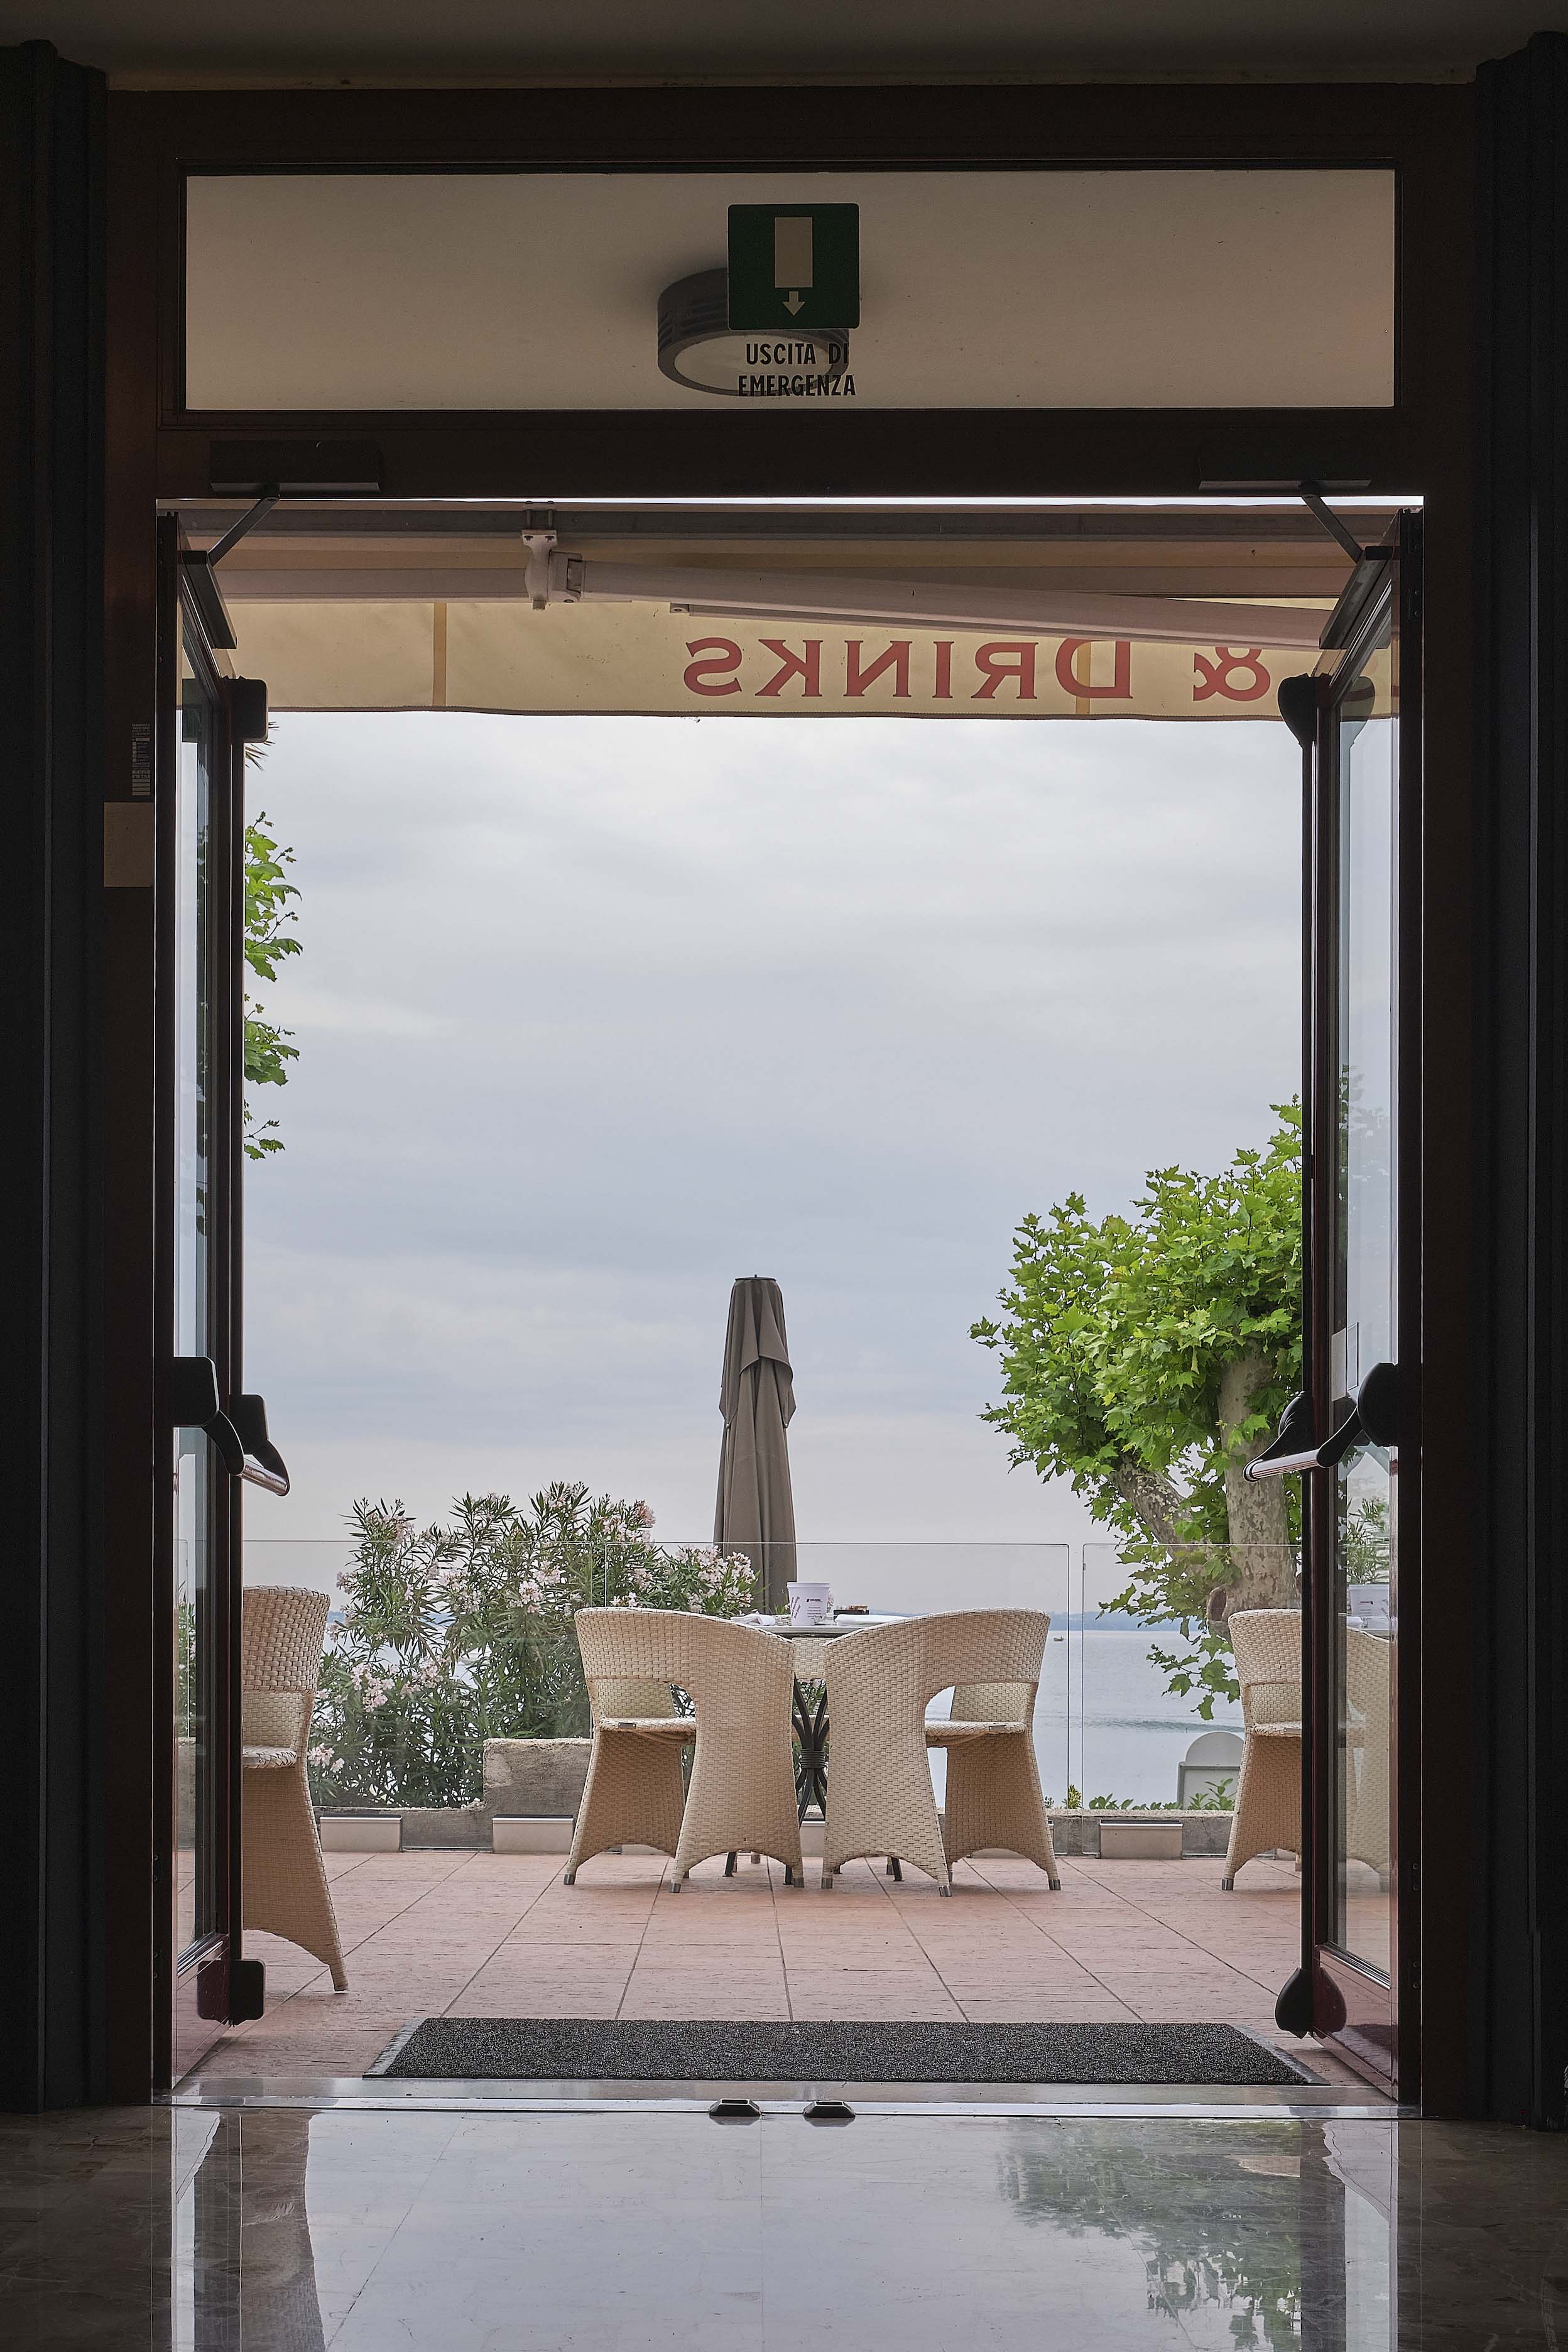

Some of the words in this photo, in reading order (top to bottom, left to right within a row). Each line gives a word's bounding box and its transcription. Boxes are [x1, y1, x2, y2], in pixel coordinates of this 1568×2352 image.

[746, 343, 815, 364] USCITA
[829, 343, 848, 364] DI
[738, 374, 856, 397] EMERGENZA
